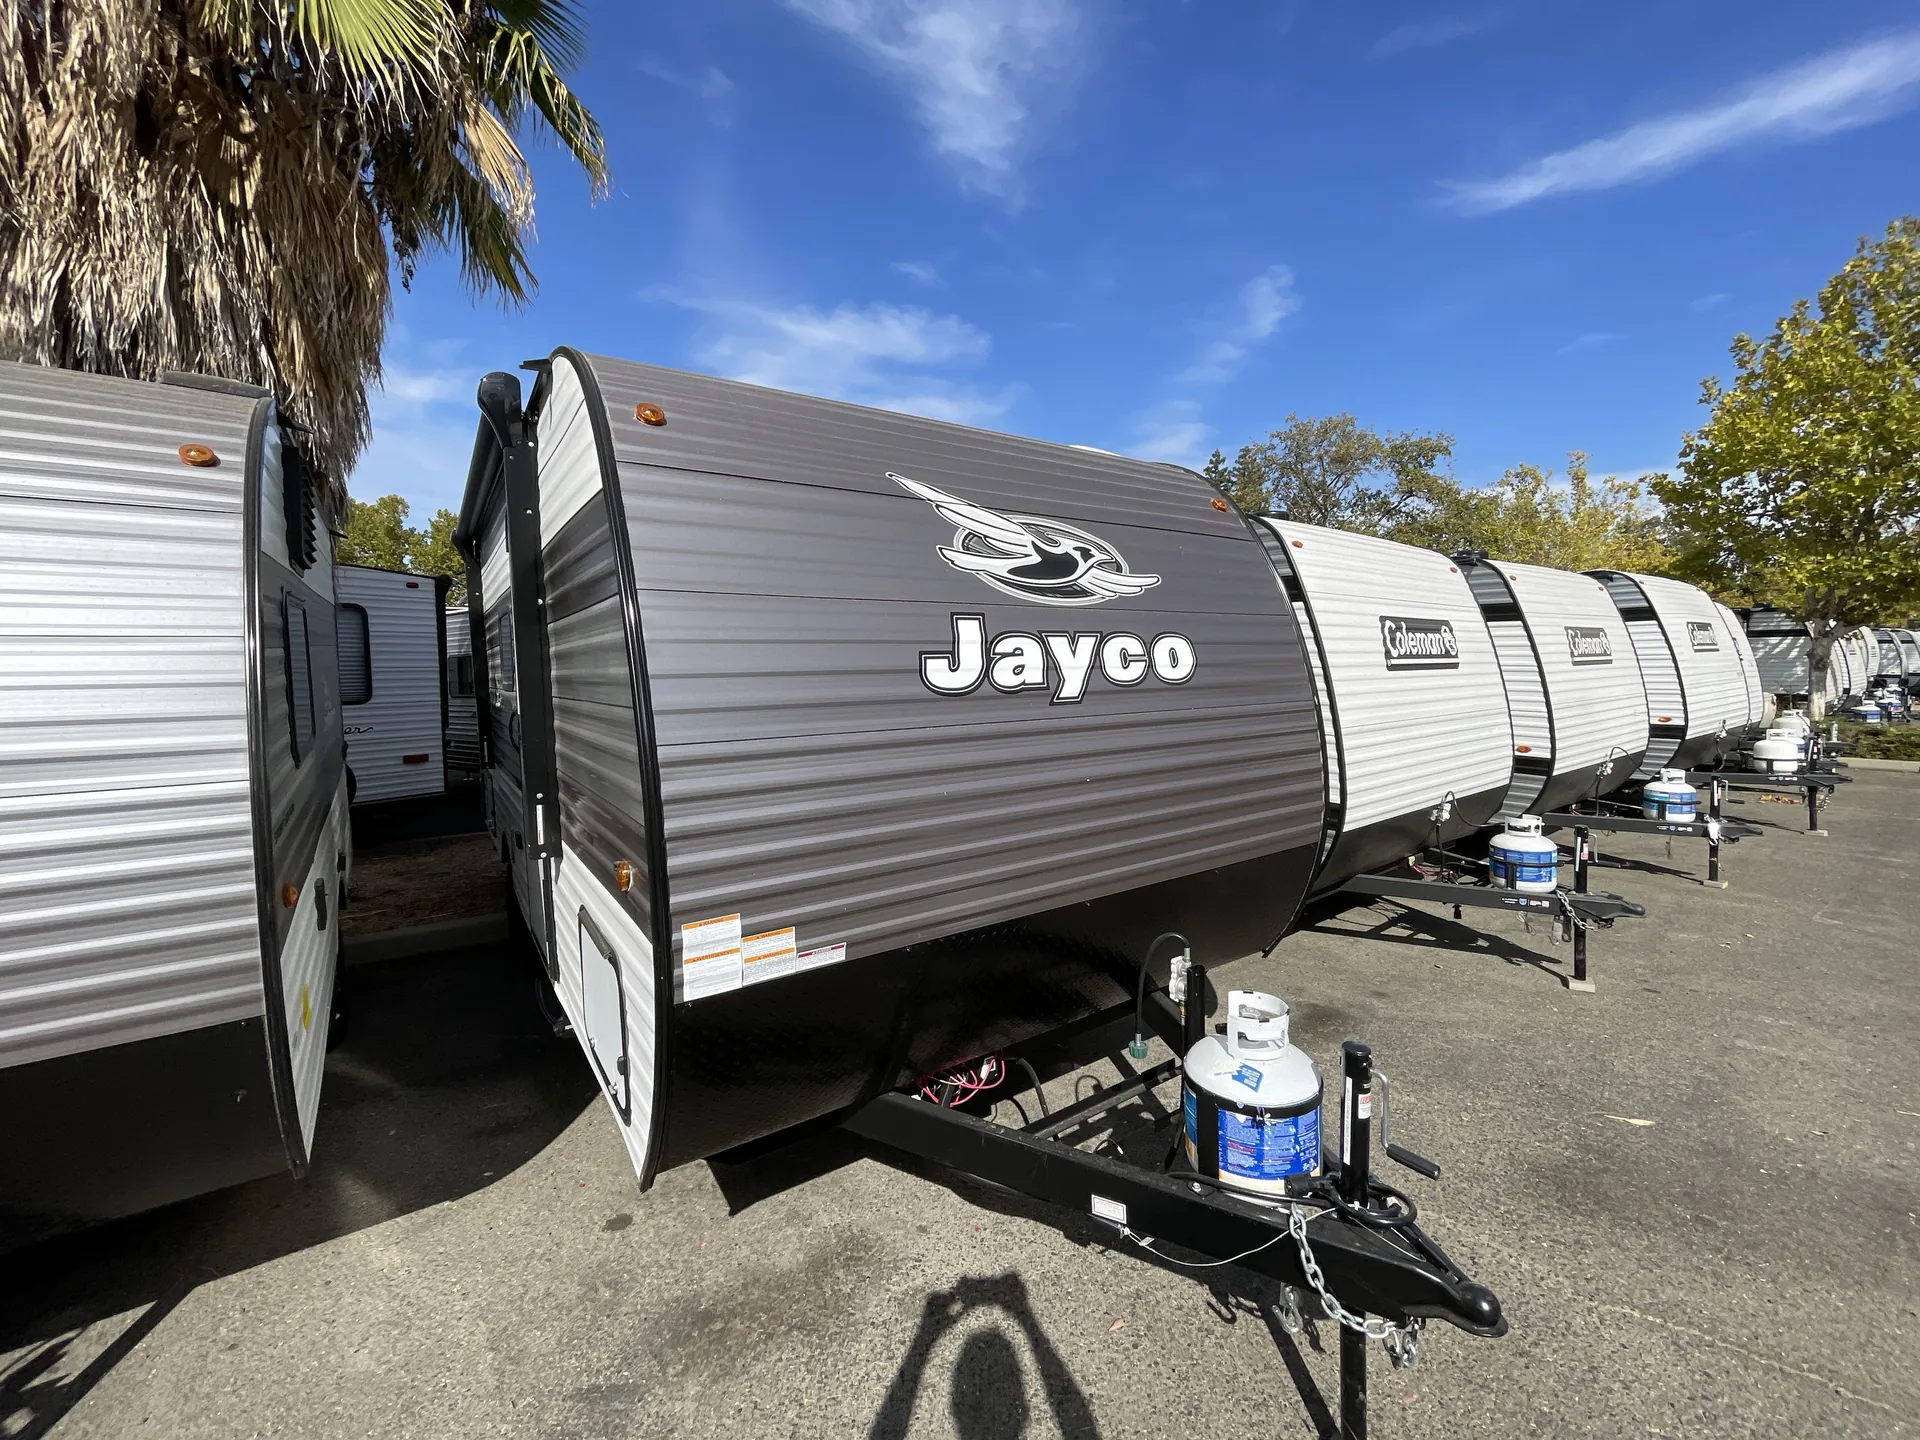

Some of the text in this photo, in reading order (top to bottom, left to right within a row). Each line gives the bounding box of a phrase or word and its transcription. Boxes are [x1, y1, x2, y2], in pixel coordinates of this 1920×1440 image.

[1384, 619, 1446, 658] Coleman
[1567, 629, 1604, 656] Coleman
[919, 612, 1197, 705] Jayco
